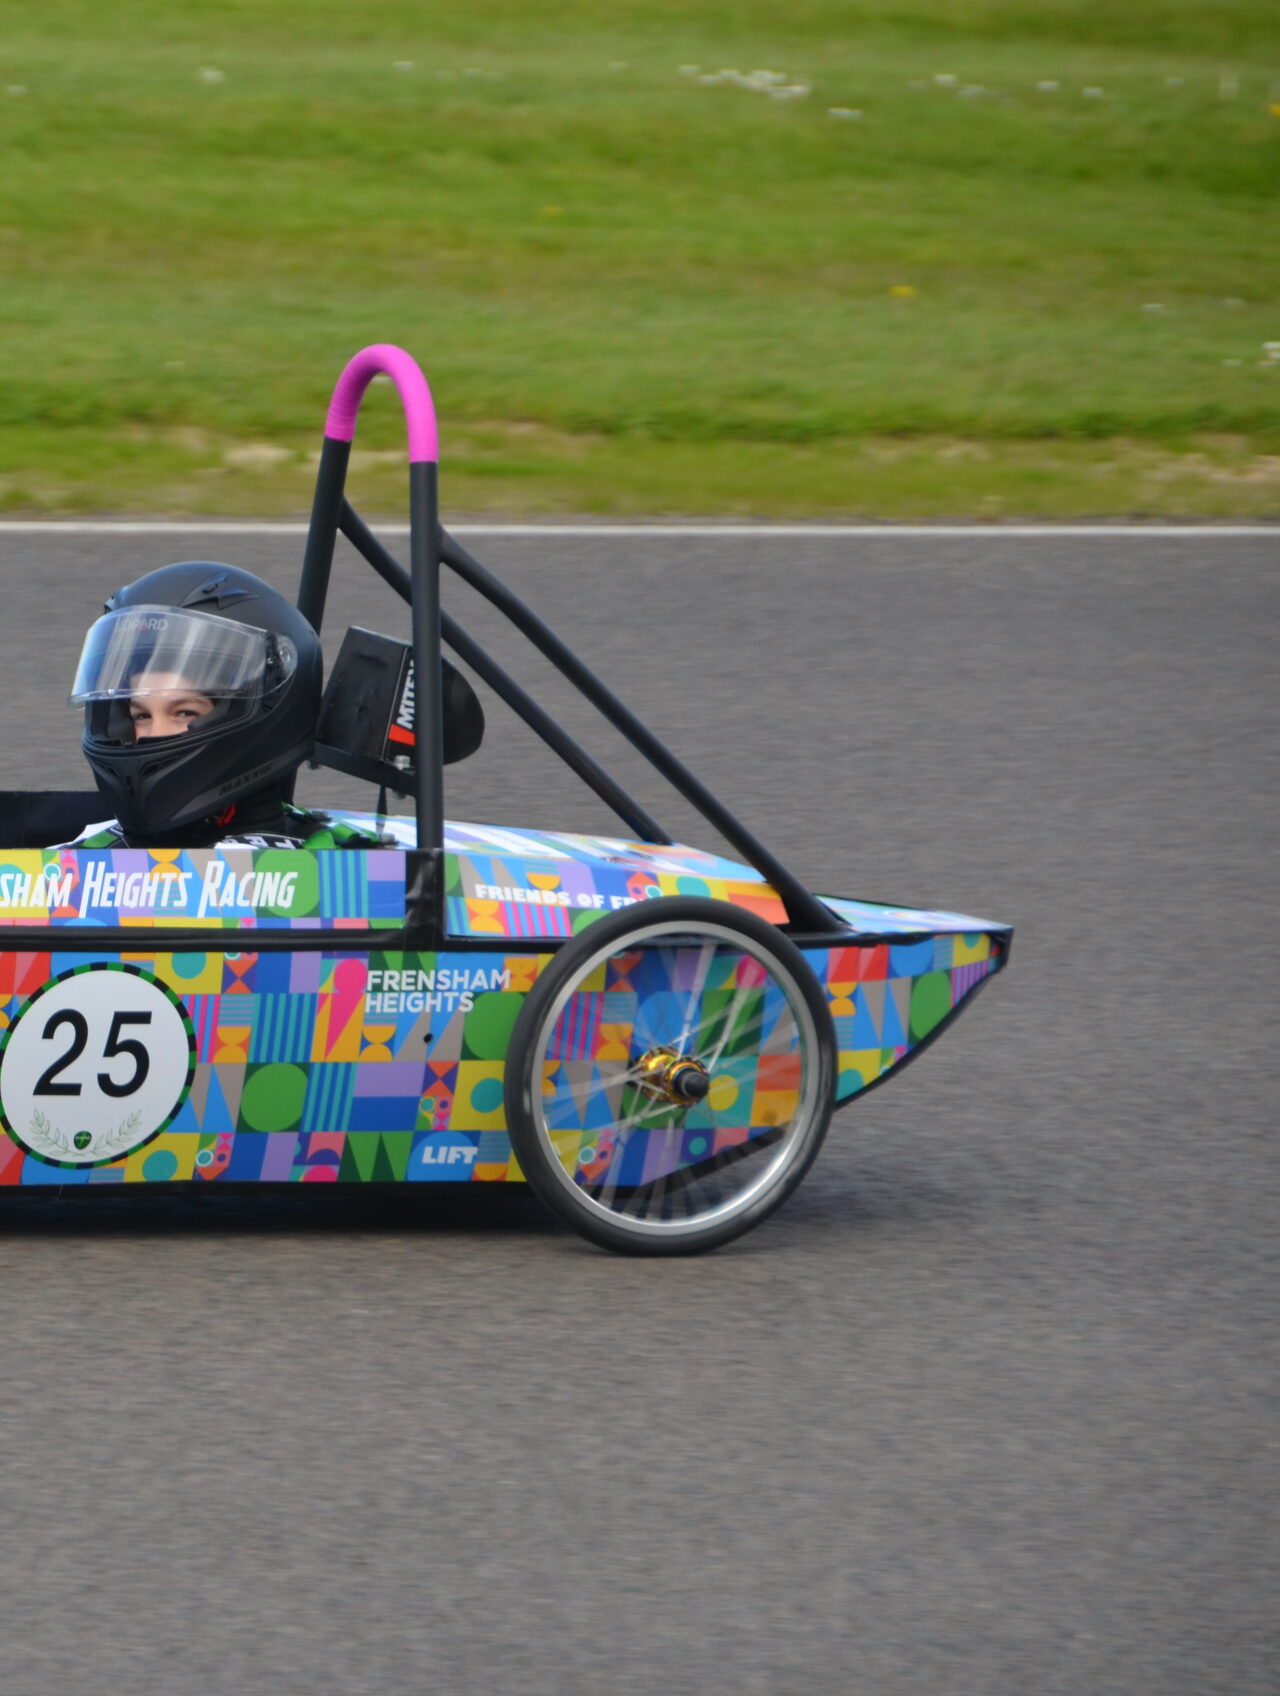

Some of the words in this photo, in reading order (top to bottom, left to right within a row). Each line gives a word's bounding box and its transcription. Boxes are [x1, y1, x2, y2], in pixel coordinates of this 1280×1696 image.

[396, 659, 415, 730] MITE
[78, 861, 193, 919] HEIGHTS
[196, 860, 298, 919] RACING
[475, 884, 571, 906] FRIENDS
[577, 892, 605, 909] OF
[366, 968, 511, 991] FRENSHAM
[364, 991, 474, 1013] HEIGHTS
[32, 1008, 152, 1098] 25
[422, 1146, 479, 1164] LIFT
